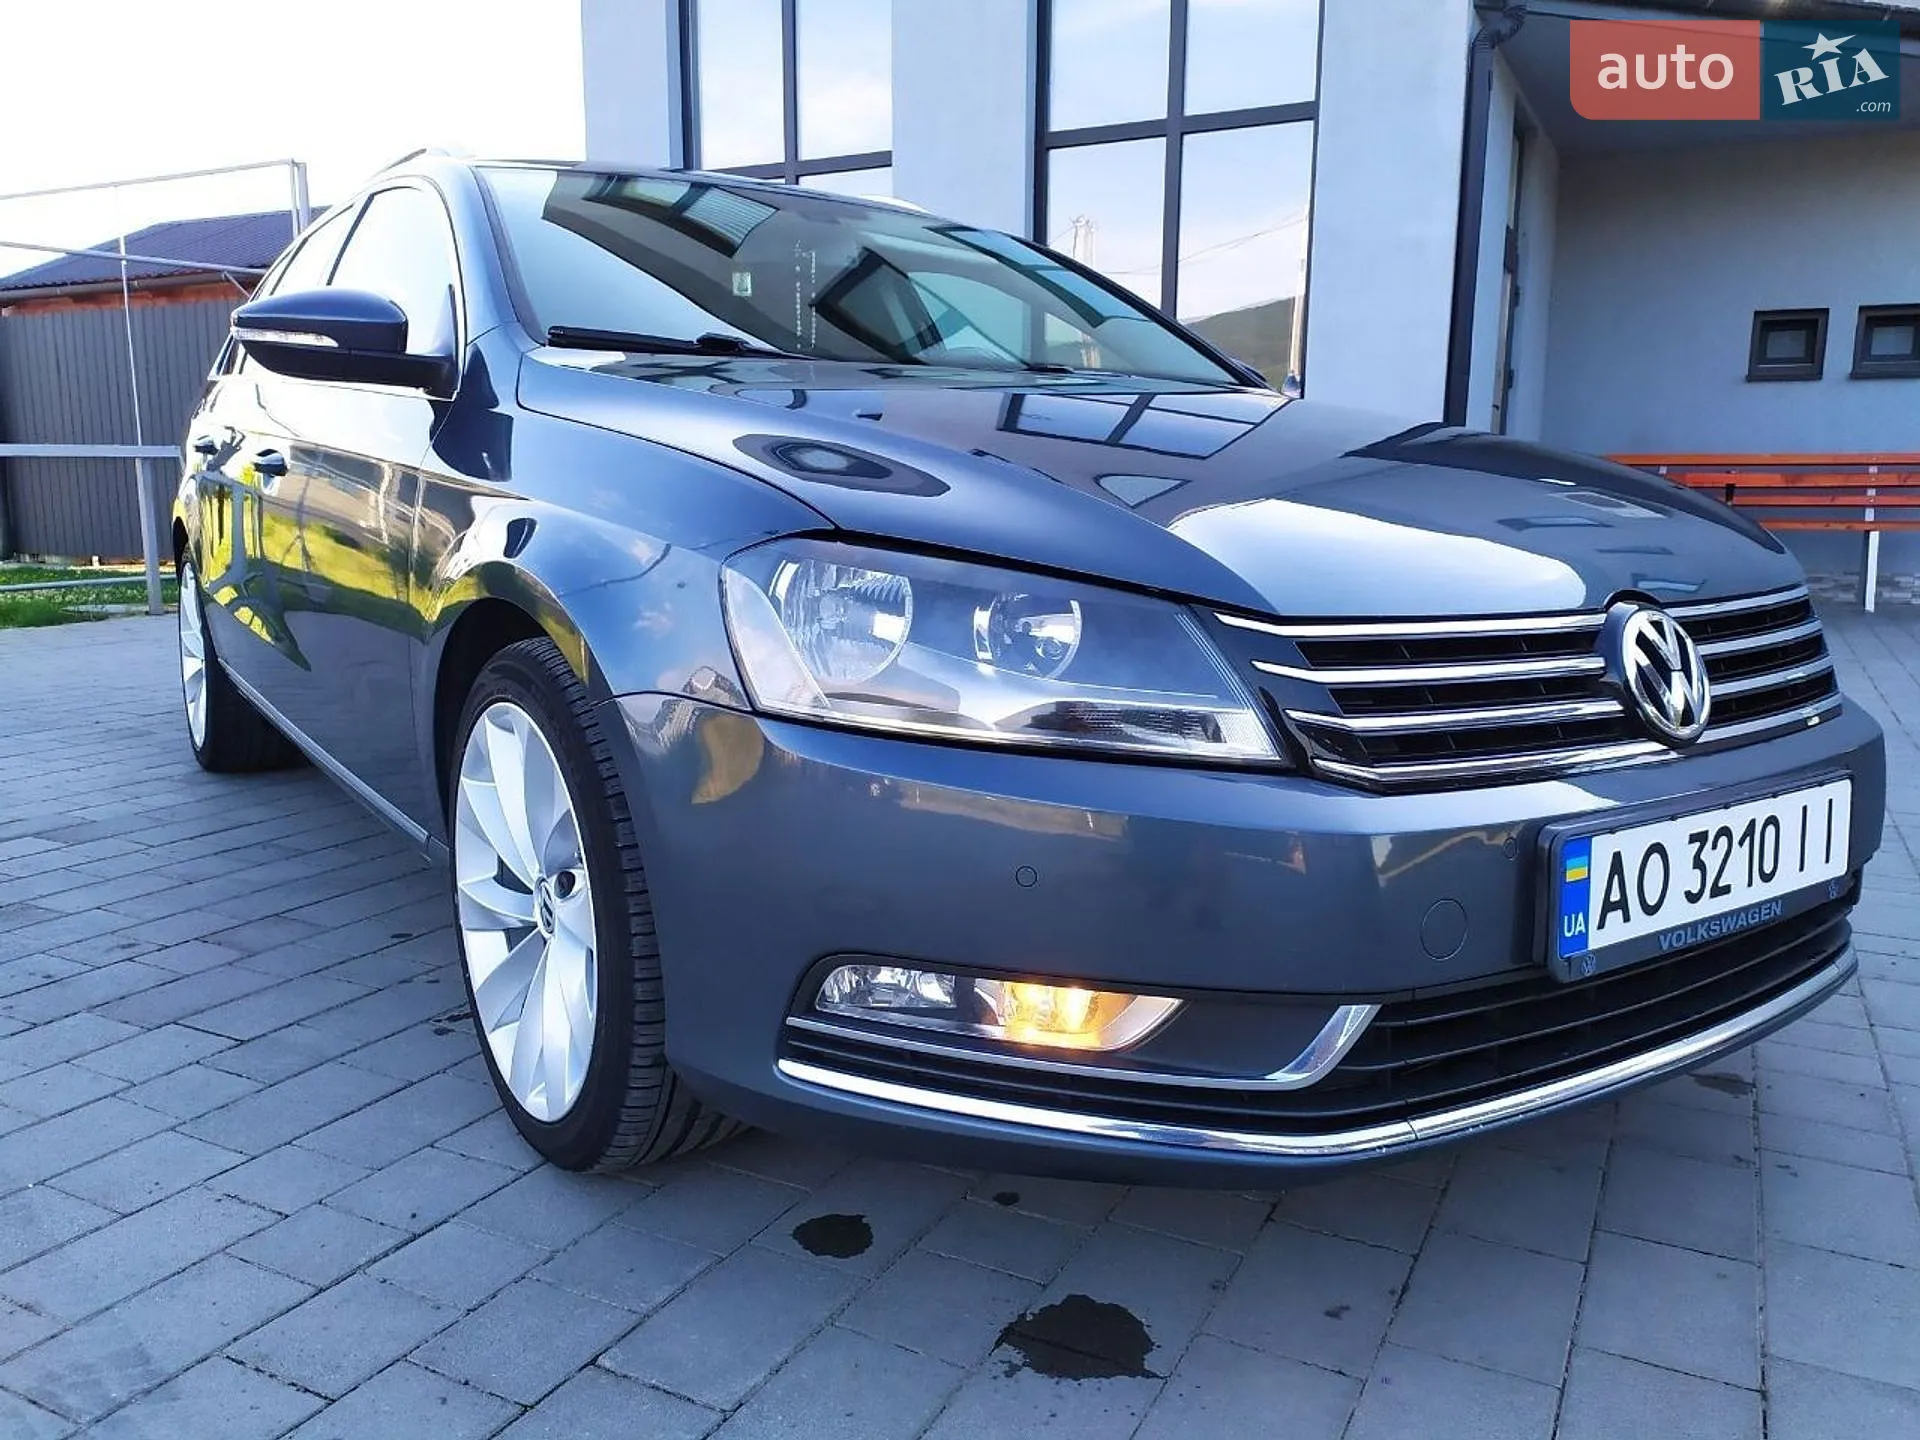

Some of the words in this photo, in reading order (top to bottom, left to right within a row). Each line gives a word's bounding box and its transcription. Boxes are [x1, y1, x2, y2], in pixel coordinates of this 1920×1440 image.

[1597, 841, 1670, 930] AO
[1684, 814, 1780, 904] 3210
[1564, 912, 1586, 938] UA
[1659, 900, 1783, 950] VOLKSWAGEN
